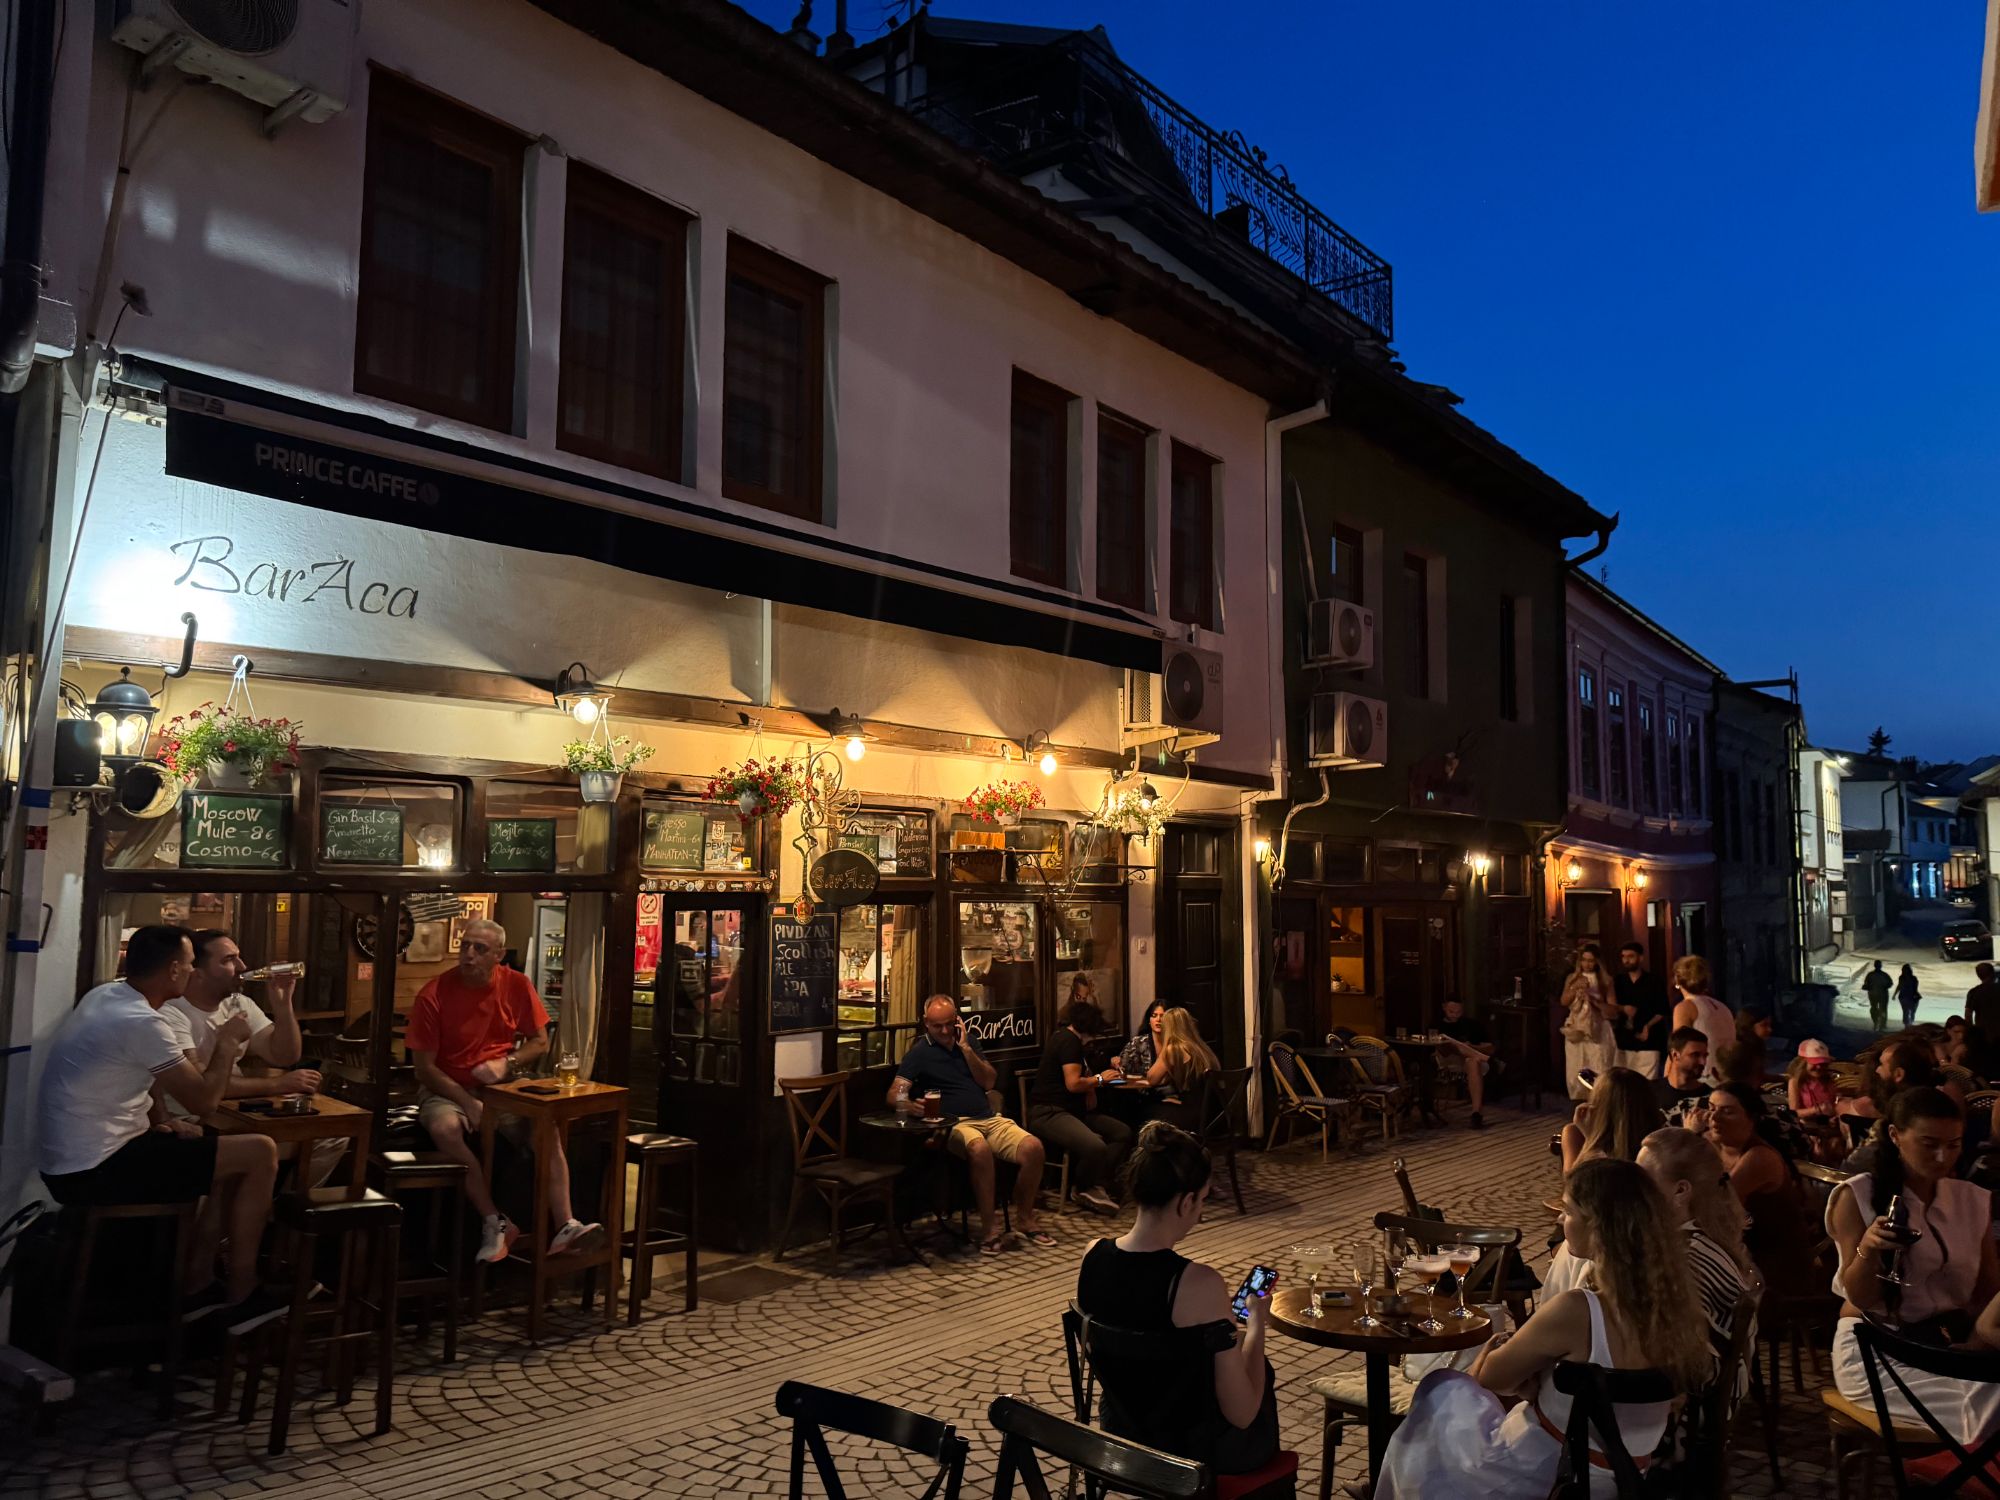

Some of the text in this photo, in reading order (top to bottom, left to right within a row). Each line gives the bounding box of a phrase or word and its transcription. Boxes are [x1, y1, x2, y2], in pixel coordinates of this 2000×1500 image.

[255, 442, 418, 501] PRINCE CAFFE
[328, 810, 348, 824] Gin
[348, 809, 375, 823] Basil
[646, 814, 687, 834] Espresso
[326, 824, 376, 838] Amaretto
[964, 1013, 1033, 1040] BarAca
